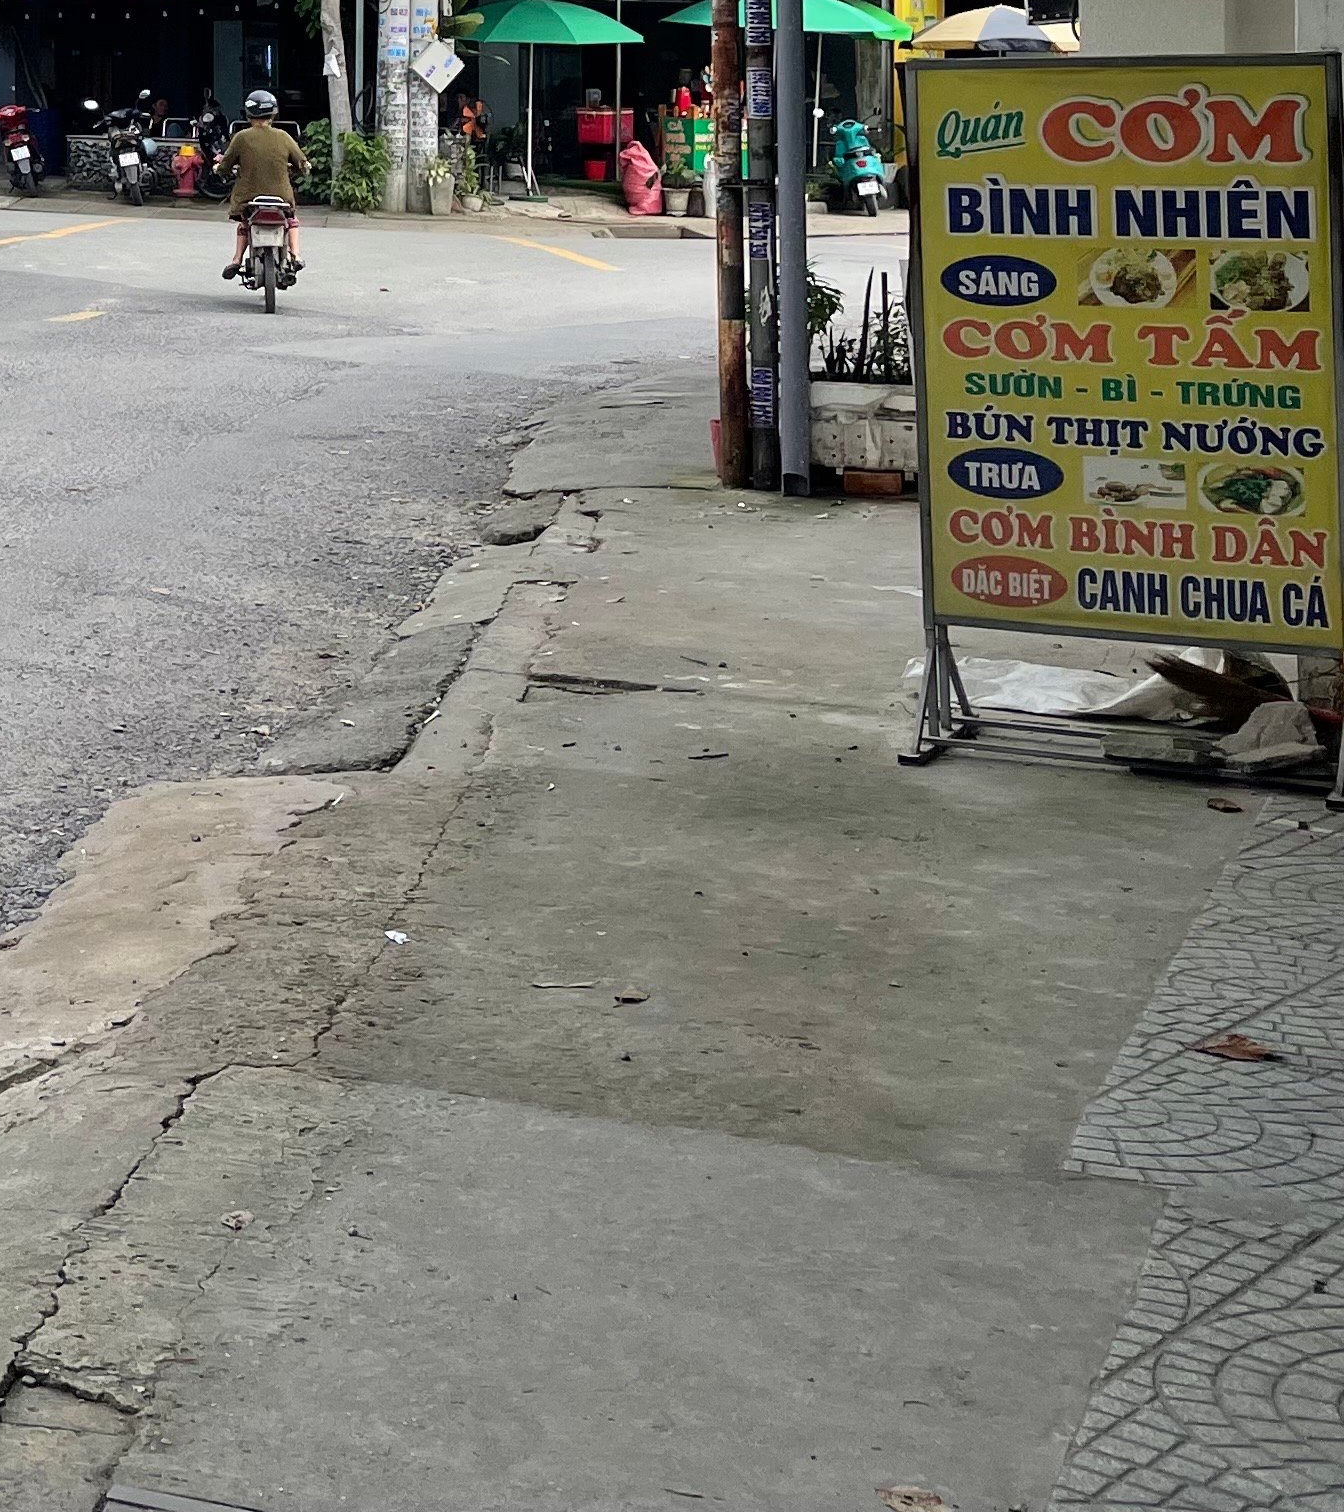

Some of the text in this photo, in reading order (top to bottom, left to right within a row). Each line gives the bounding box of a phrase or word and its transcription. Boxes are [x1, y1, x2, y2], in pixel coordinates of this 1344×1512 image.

[937, 87, 1305, 164] Quán CƠM
[947, 177, 1311, 240] BÌNH NHIÊN
[958, 259, 1040, 298] SÁNG
[942, 308, 1321, 372] CƠM TẤM
[965, 371, 1063, 400] SƯỜN
[1102, 372, 1136, 403] BÌ
[1176, 377, 1302, 410] TRỨNG
[946, 410, 1325, 459] BÚN THỊT NƯỚNG
[964, 459, 1042, 492] TRƯA
[949, 505, 1327, 570] CƠM BÌNH DÂN
[961, 565, 1331, 630] ĐẶC BIỆT CANH CHUA CÁ
